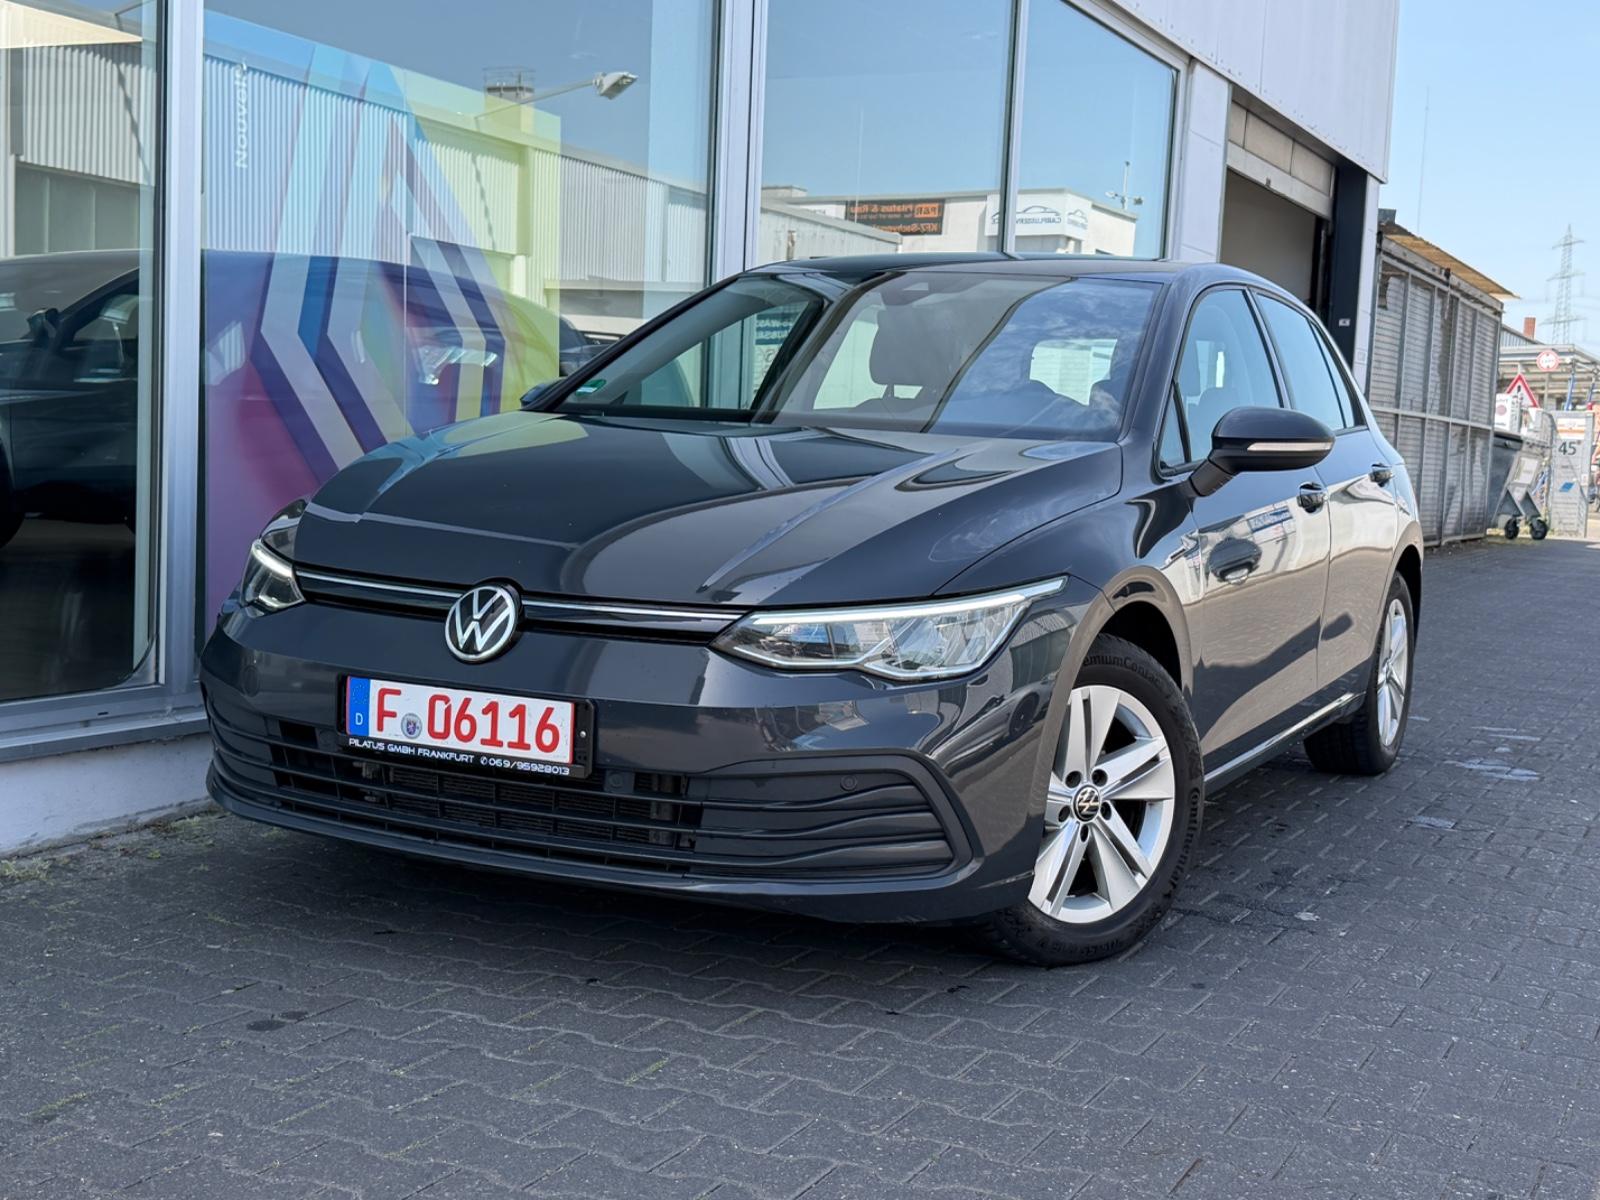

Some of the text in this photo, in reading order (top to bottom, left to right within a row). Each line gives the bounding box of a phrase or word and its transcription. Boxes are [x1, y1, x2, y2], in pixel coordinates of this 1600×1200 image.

[1558, 441, 1577, 456] 45
[355, 712, 364, 726] D
[376, 687, 560, 754] F 06116
[348, 738, 570, 776] PILATUS GMBH FRANKFURT 069/95928013
